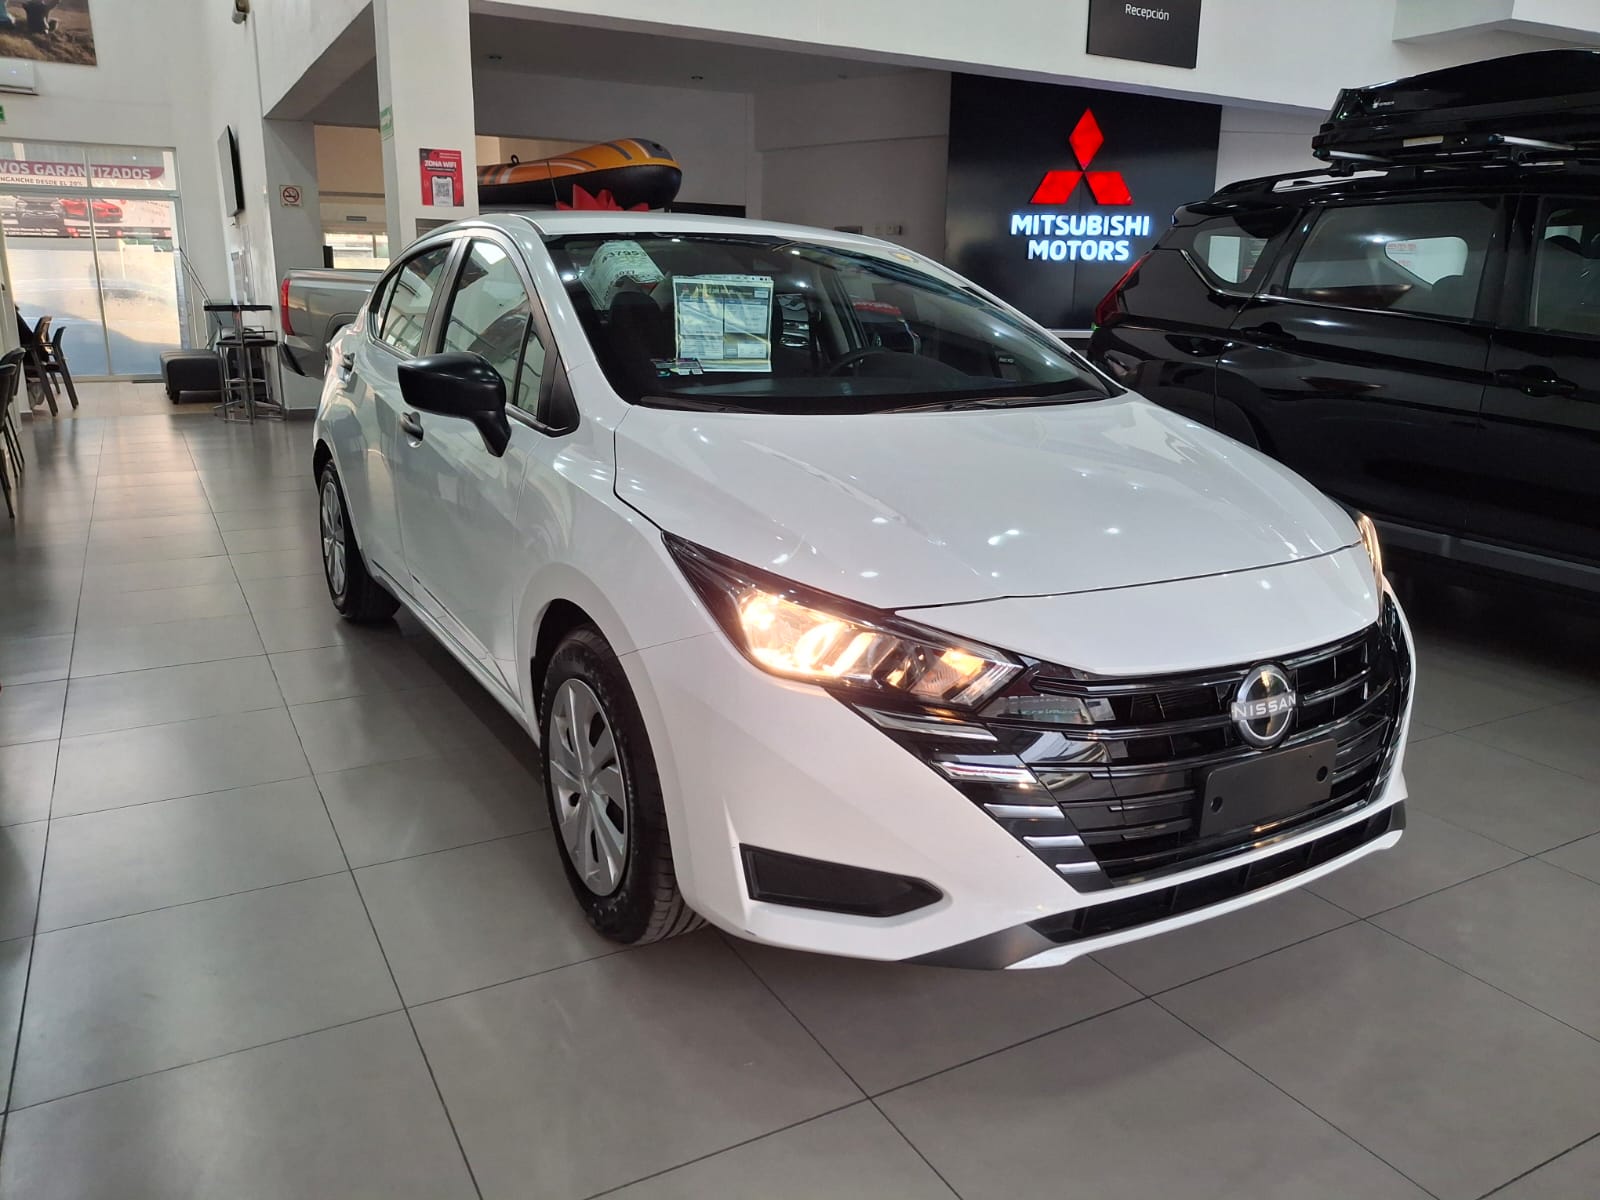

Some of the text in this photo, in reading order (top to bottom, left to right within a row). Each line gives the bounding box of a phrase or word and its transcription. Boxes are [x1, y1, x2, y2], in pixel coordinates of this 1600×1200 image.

[1125, 4, 1170, 21] Recepción
[33, 164, 152, 180] GARANTIZADOS
[1011, 214, 1150, 236] MITSUBISHI
[1027, 239, 1130, 261] MOTORS
[1233, 692, 1297, 719] NISSAN
